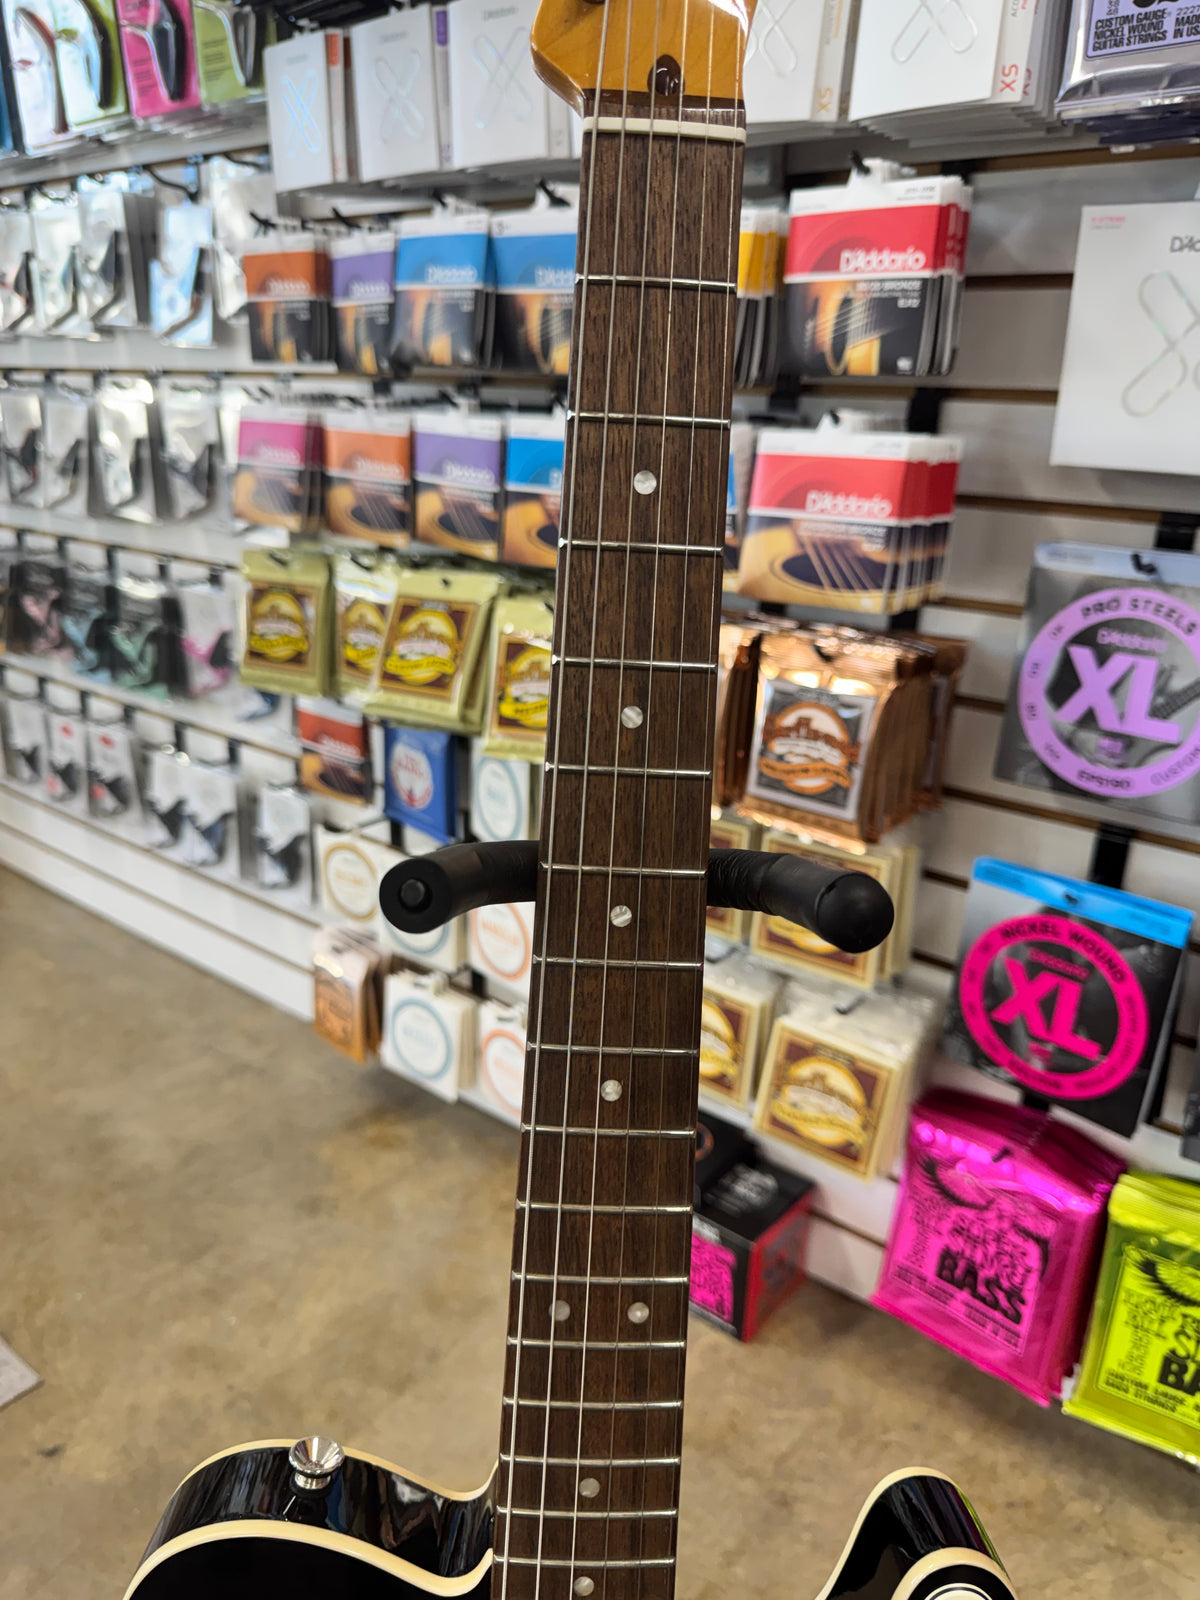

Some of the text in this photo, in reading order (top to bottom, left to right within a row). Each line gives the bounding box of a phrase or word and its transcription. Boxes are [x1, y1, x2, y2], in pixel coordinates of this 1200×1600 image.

[1093, 20, 1164, 42] NICKEL WOUND
[1095, 8, 1168, 30] CUSTOM GAUGE
[1173, 27, 1184, 39] IN
[1092, 30, 1168, 52] GUITAR STRINGS
[1000, 64, 1019, 93] XS
[1081, 597, 1198, 636] PRO STEELS
[1054, 643, 1182, 745] XL
[999, 920, 1127, 984] NICKEL WOUND
[990, 956, 1103, 1061] XL
[937, 1243, 1028, 1325] BASS
